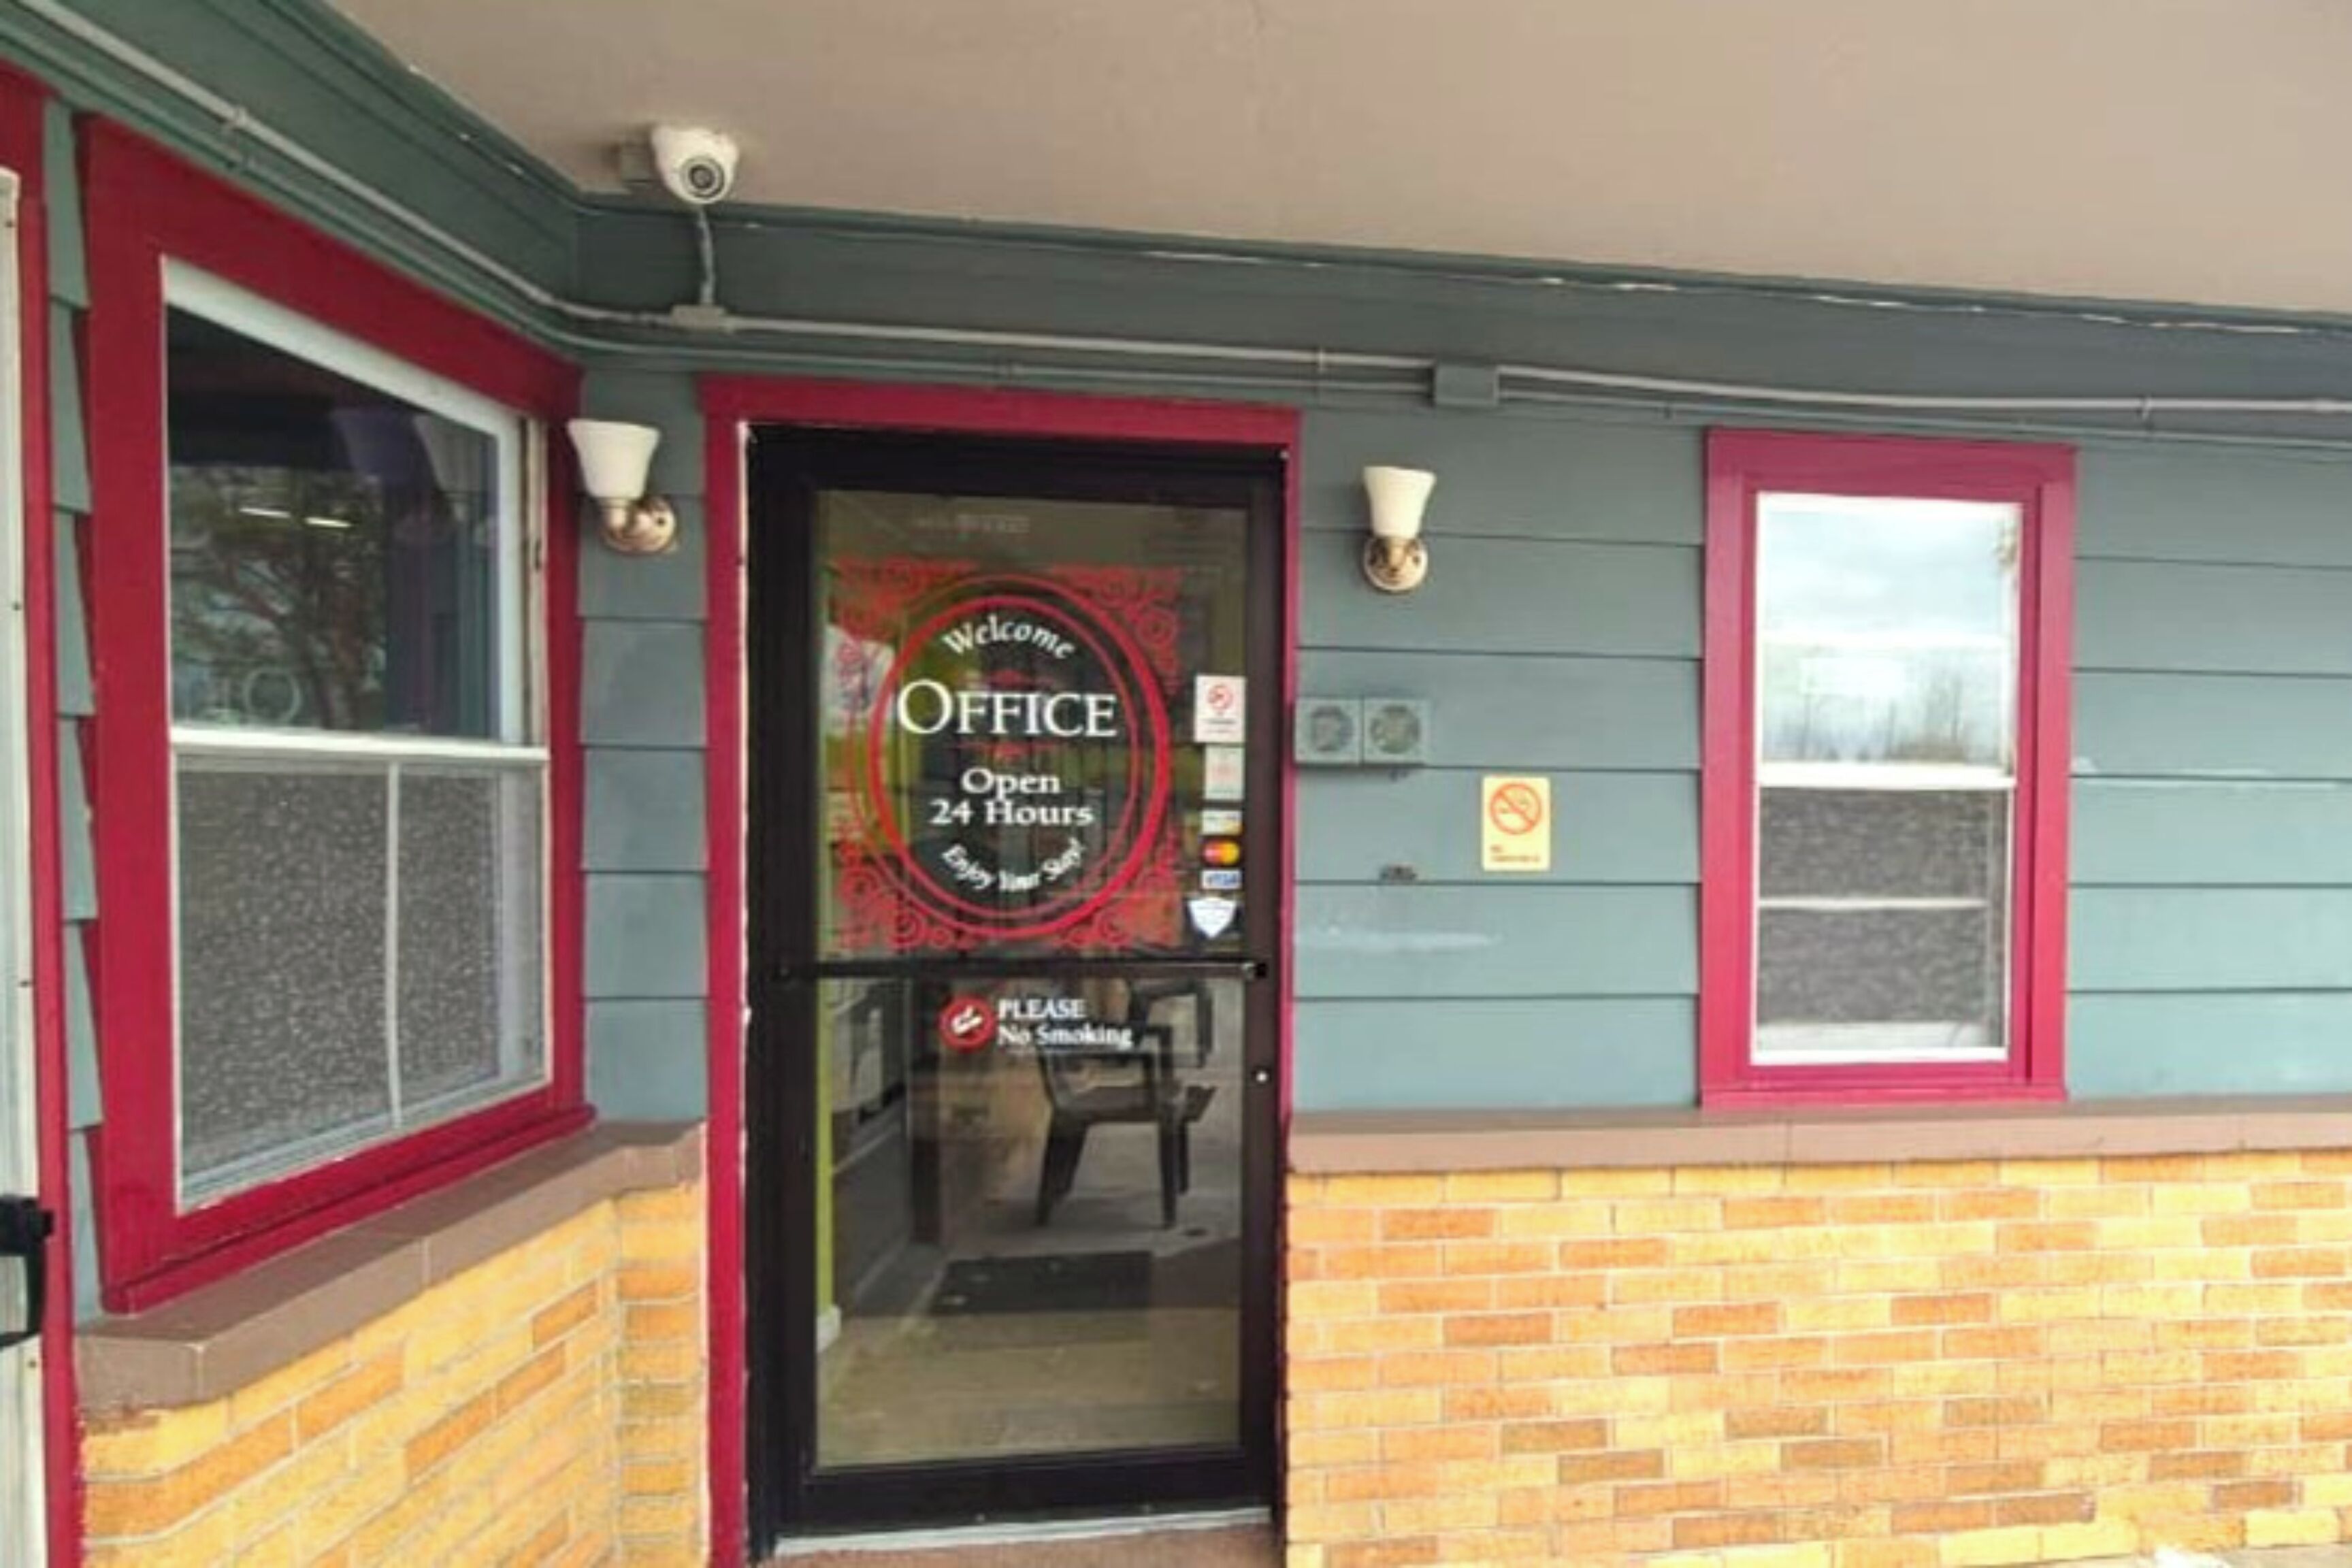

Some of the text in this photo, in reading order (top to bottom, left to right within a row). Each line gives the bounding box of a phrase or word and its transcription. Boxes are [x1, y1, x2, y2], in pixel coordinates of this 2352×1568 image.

[942, 614, 1076, 661] Welcome
[896, 679, 1117, 737] OFFICE
[961, 766, 1061, 800] Open
[928, 798, 1094, 826] 24 Hours
[941, 844, 995, 890] Enjoy
[998, 998, 1087, 1019] PLEASE
[998, 1022, 1134, 1050] No Smoking
